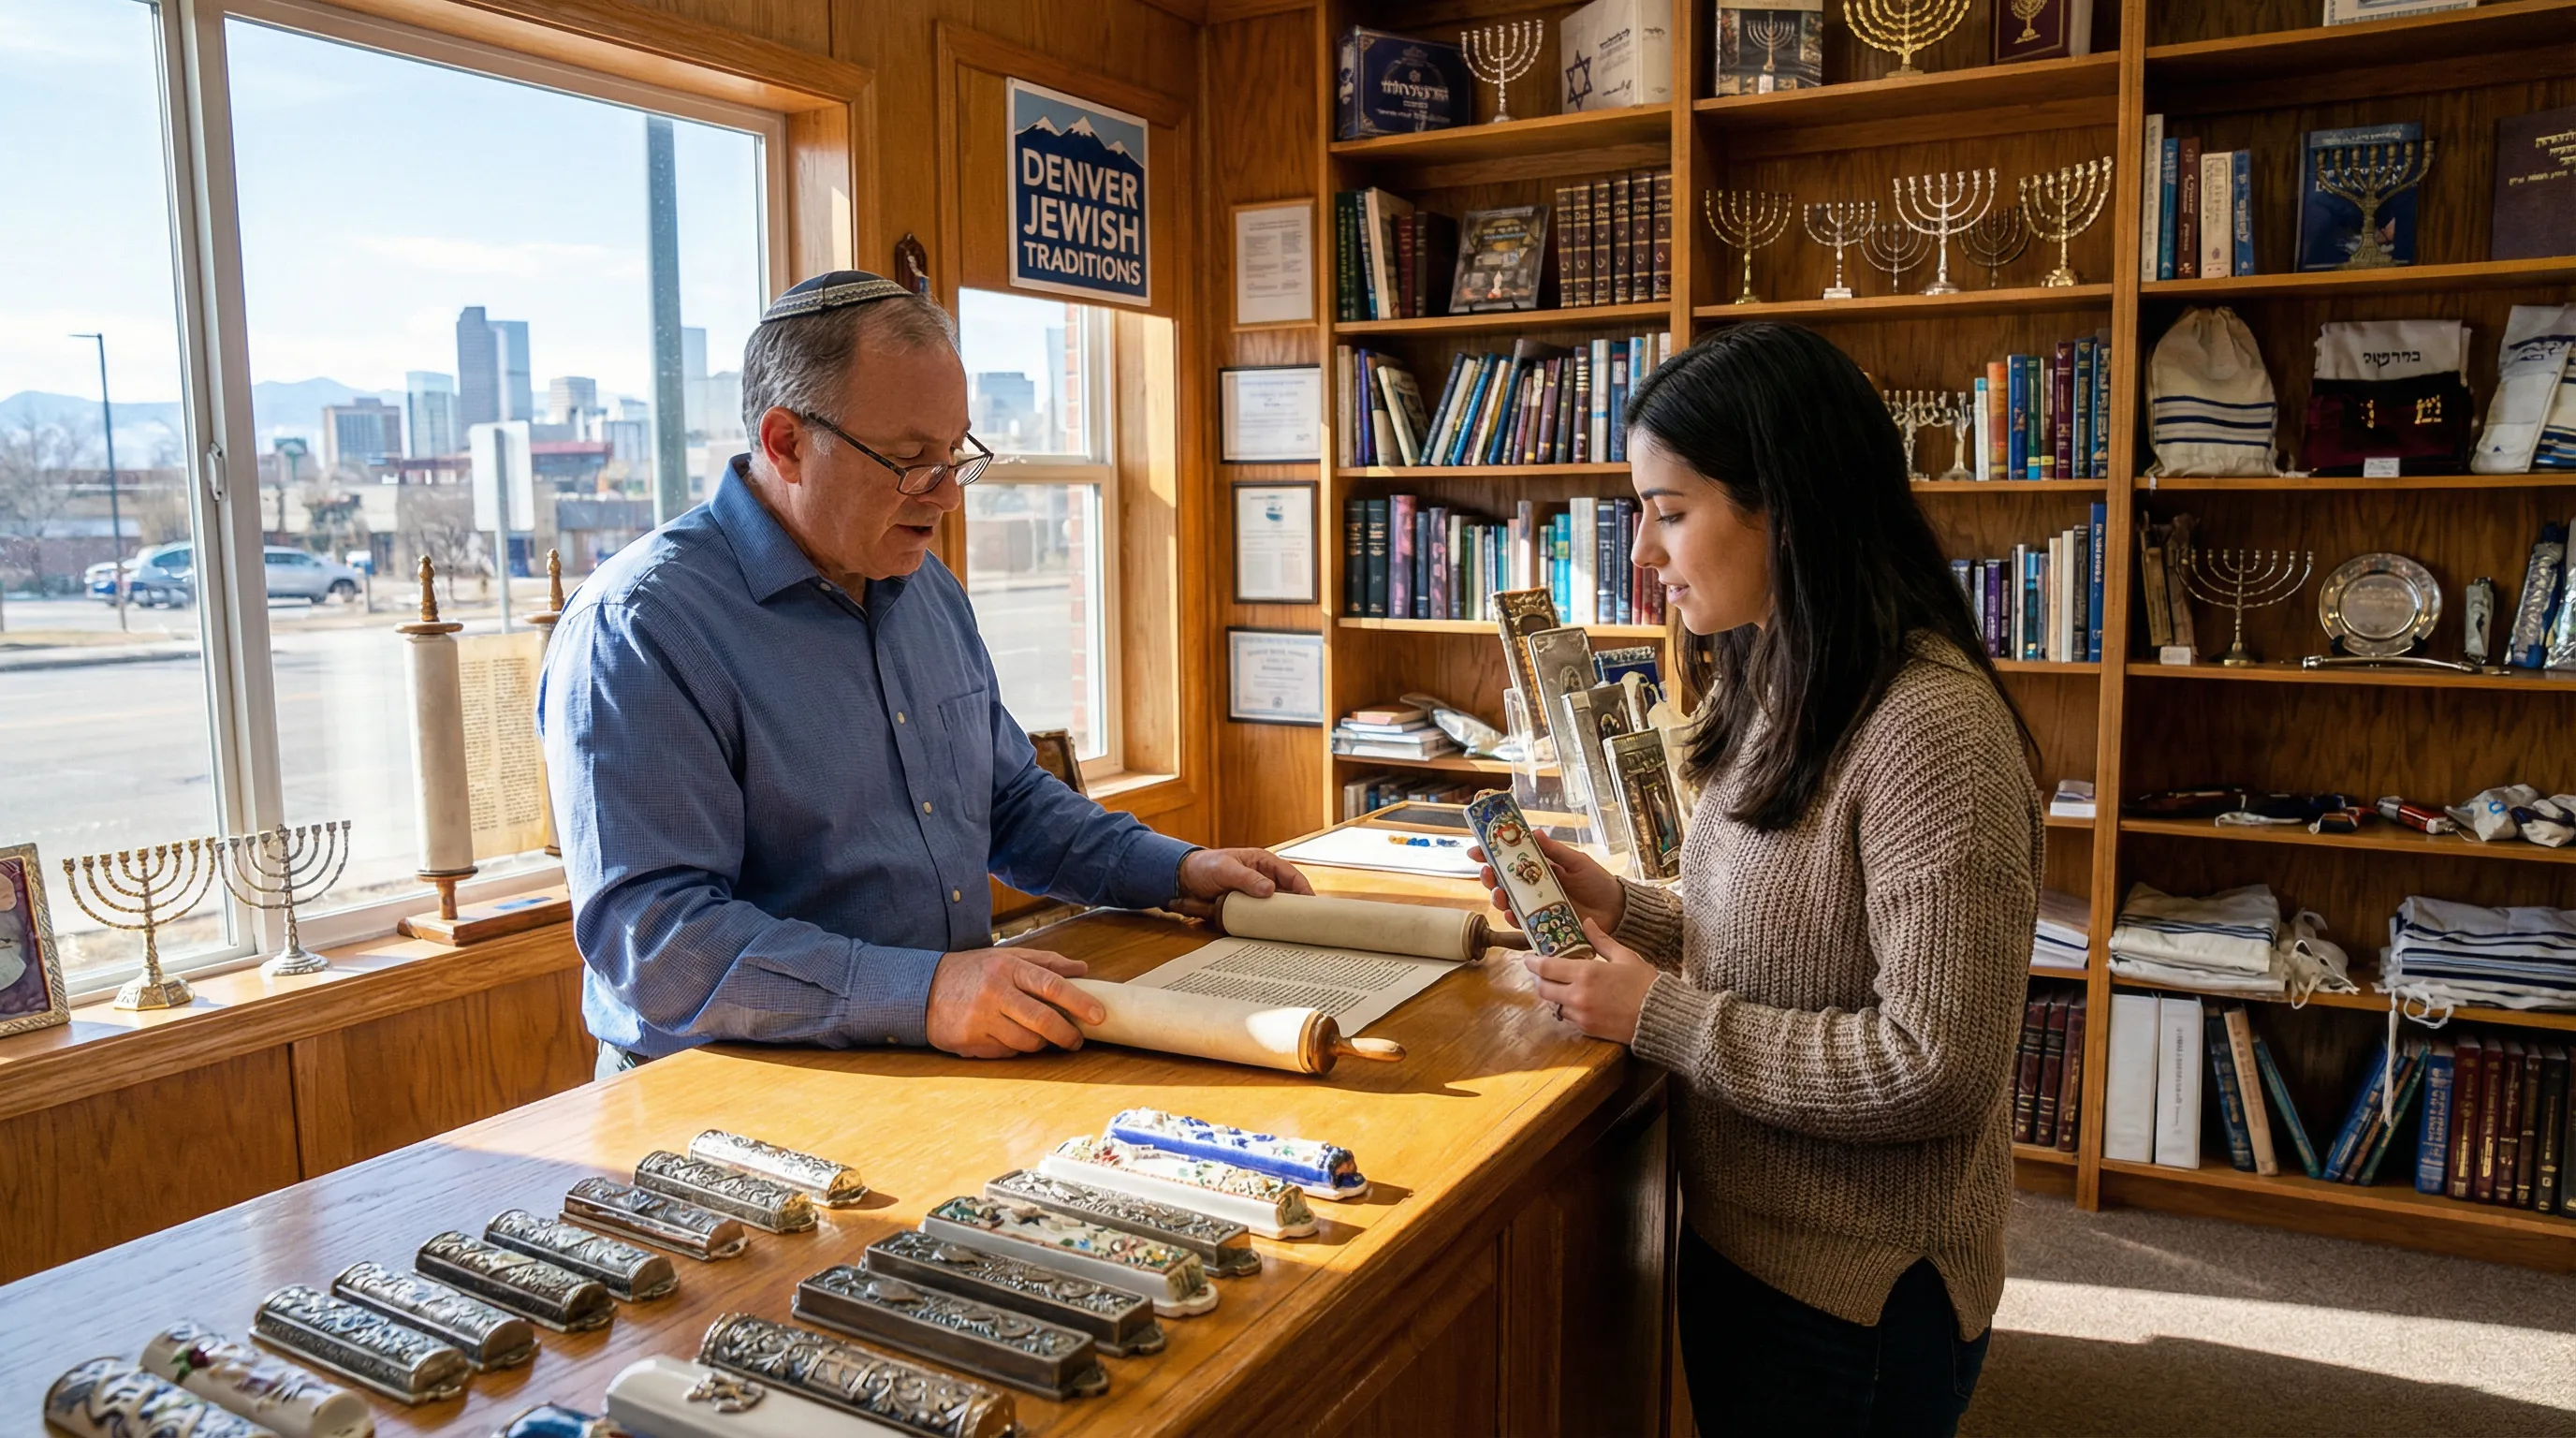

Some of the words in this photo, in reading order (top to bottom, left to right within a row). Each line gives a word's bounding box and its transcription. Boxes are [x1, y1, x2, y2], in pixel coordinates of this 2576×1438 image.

[1022, 148, 1138, 210] DENVER
[1023, 194, 1139, 256] JEWISH
[1023, 241, 1141, 286] TRADITIONS
